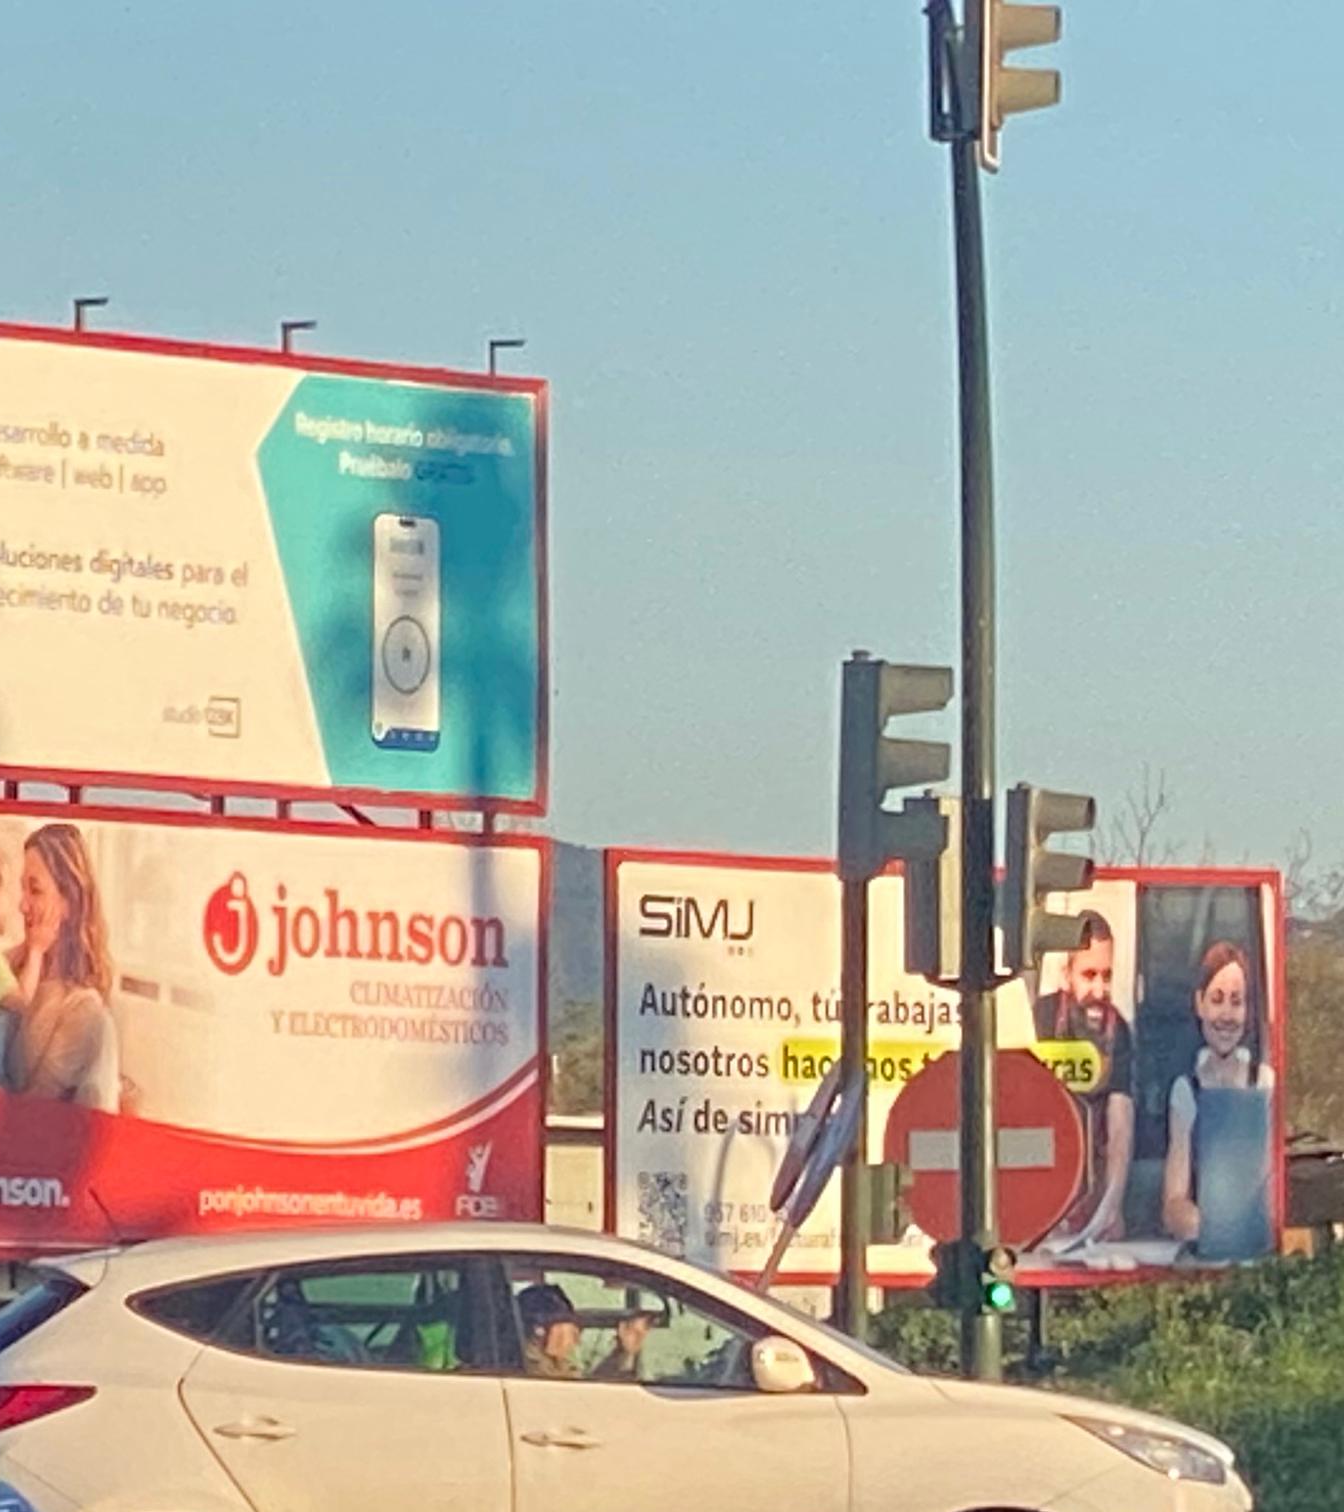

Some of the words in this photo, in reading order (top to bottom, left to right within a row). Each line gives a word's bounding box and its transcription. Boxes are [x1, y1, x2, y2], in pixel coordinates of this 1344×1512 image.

[96, 431, 165, 457] medida
[295, 411, 363, 445] Registro
[73, 463, 114, 490] web
[89, 547, 173, 582] digitales
[181, 563, 225, 588] para
[230, 561, 249, 588] el
[97, 591, 124, 615] de
[131, 595, 151, 618] tu
[267, 883, 509, 977] johnson
[349, 981, 508, 1013] CLIMATIZACIÓN
[639, 982, 801, 1028] Autónomo,
[866, 990, 962, 1034] rabaja
[270, 1010, 285, 1035] Y
[289, 1011, 510, 1047] ELECTRODOMÉSTICOS
[640, 1046, 769, 1077] nosotros
[637, 1097, 686, 1133] Así
[694, 1099, 729, 1132] de
